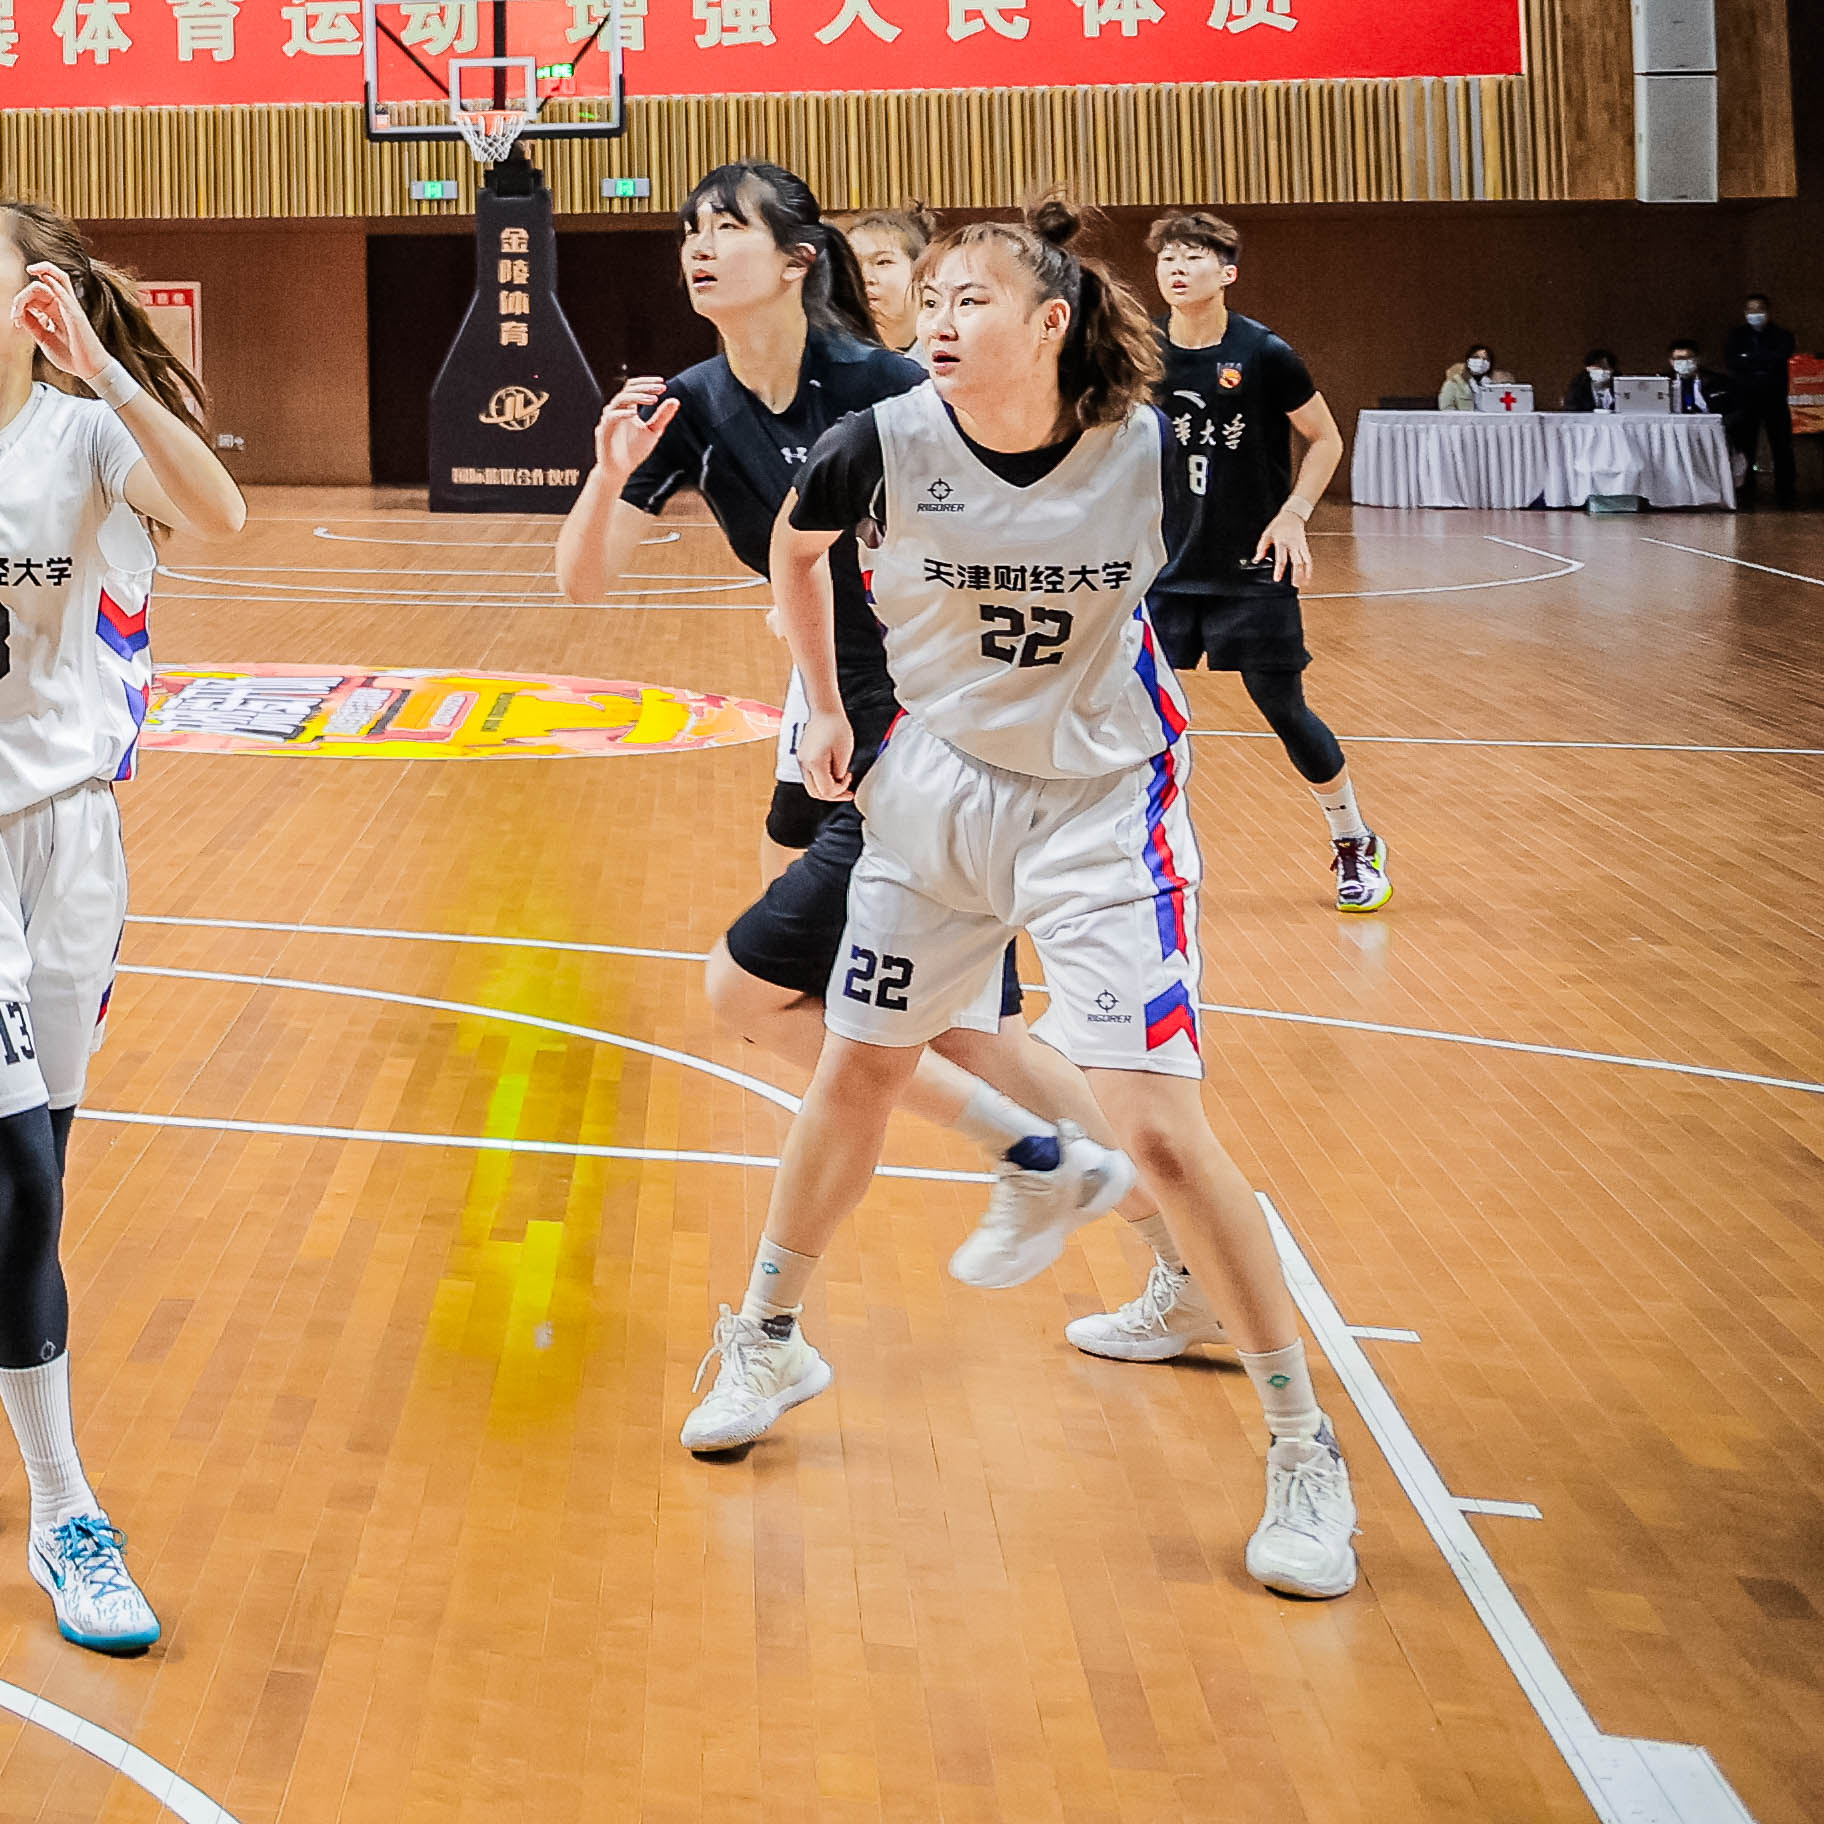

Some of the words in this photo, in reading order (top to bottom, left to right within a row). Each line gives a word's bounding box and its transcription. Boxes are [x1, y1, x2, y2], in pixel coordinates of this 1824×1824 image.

[497, 227, 530, 347] 金陵体育
[1188, 454, 1209, 495] 8
[916, 502, 966, 514] RIGORER
[923, 557, 1134, 595] 天津财经大学
[979, 604, 1074, 669] 22
[843, 944, 915, 1012] 22
[1086, 1013, 1133, 1025] RIGORER
